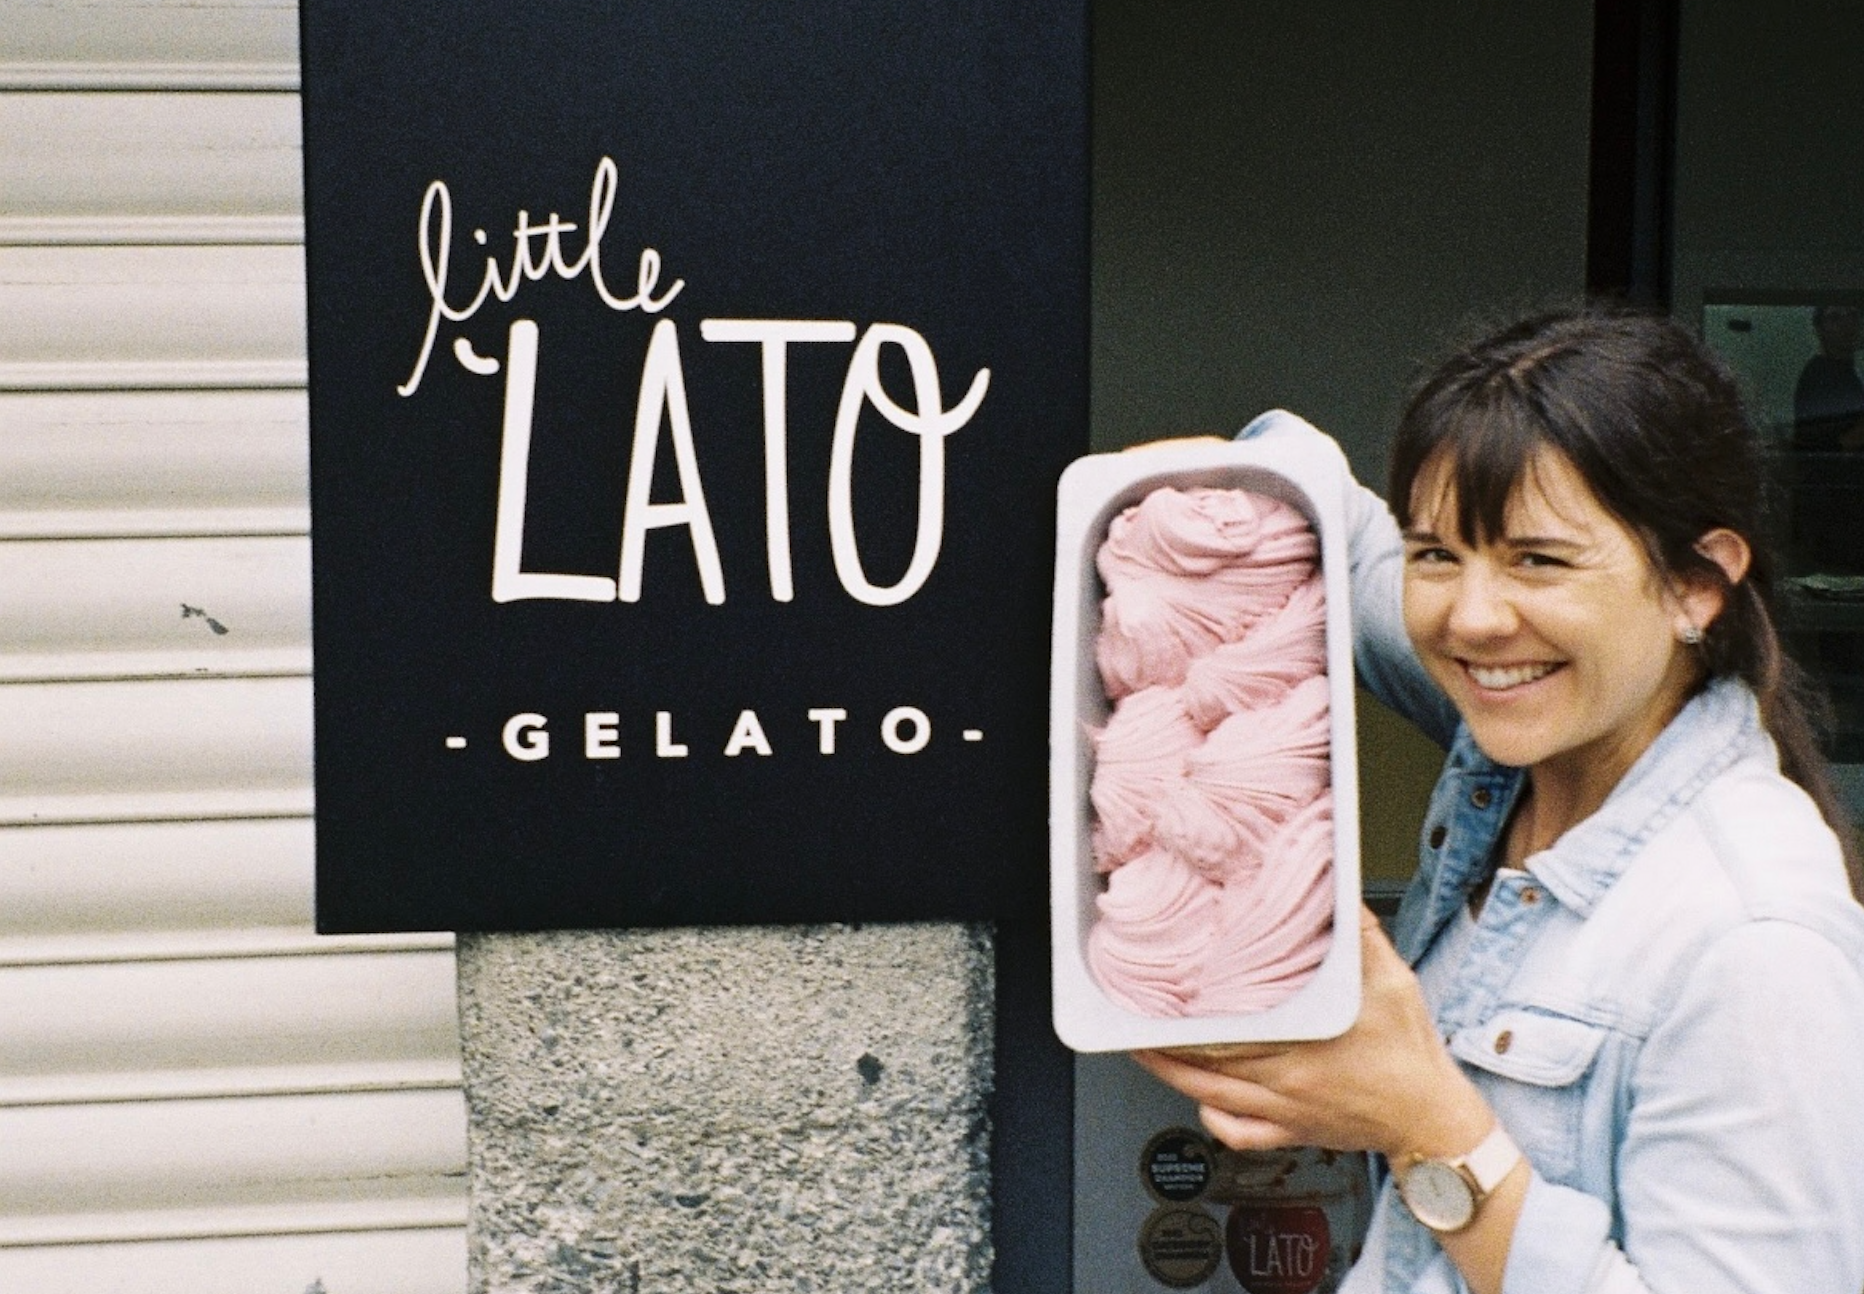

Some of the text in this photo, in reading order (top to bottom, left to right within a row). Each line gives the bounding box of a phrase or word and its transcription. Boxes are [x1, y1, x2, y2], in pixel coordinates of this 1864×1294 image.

[397, 156, 686, 397] little
[454, 318, 991, 607] LATO
[1246, 1233, 1320, 1277] LATO
